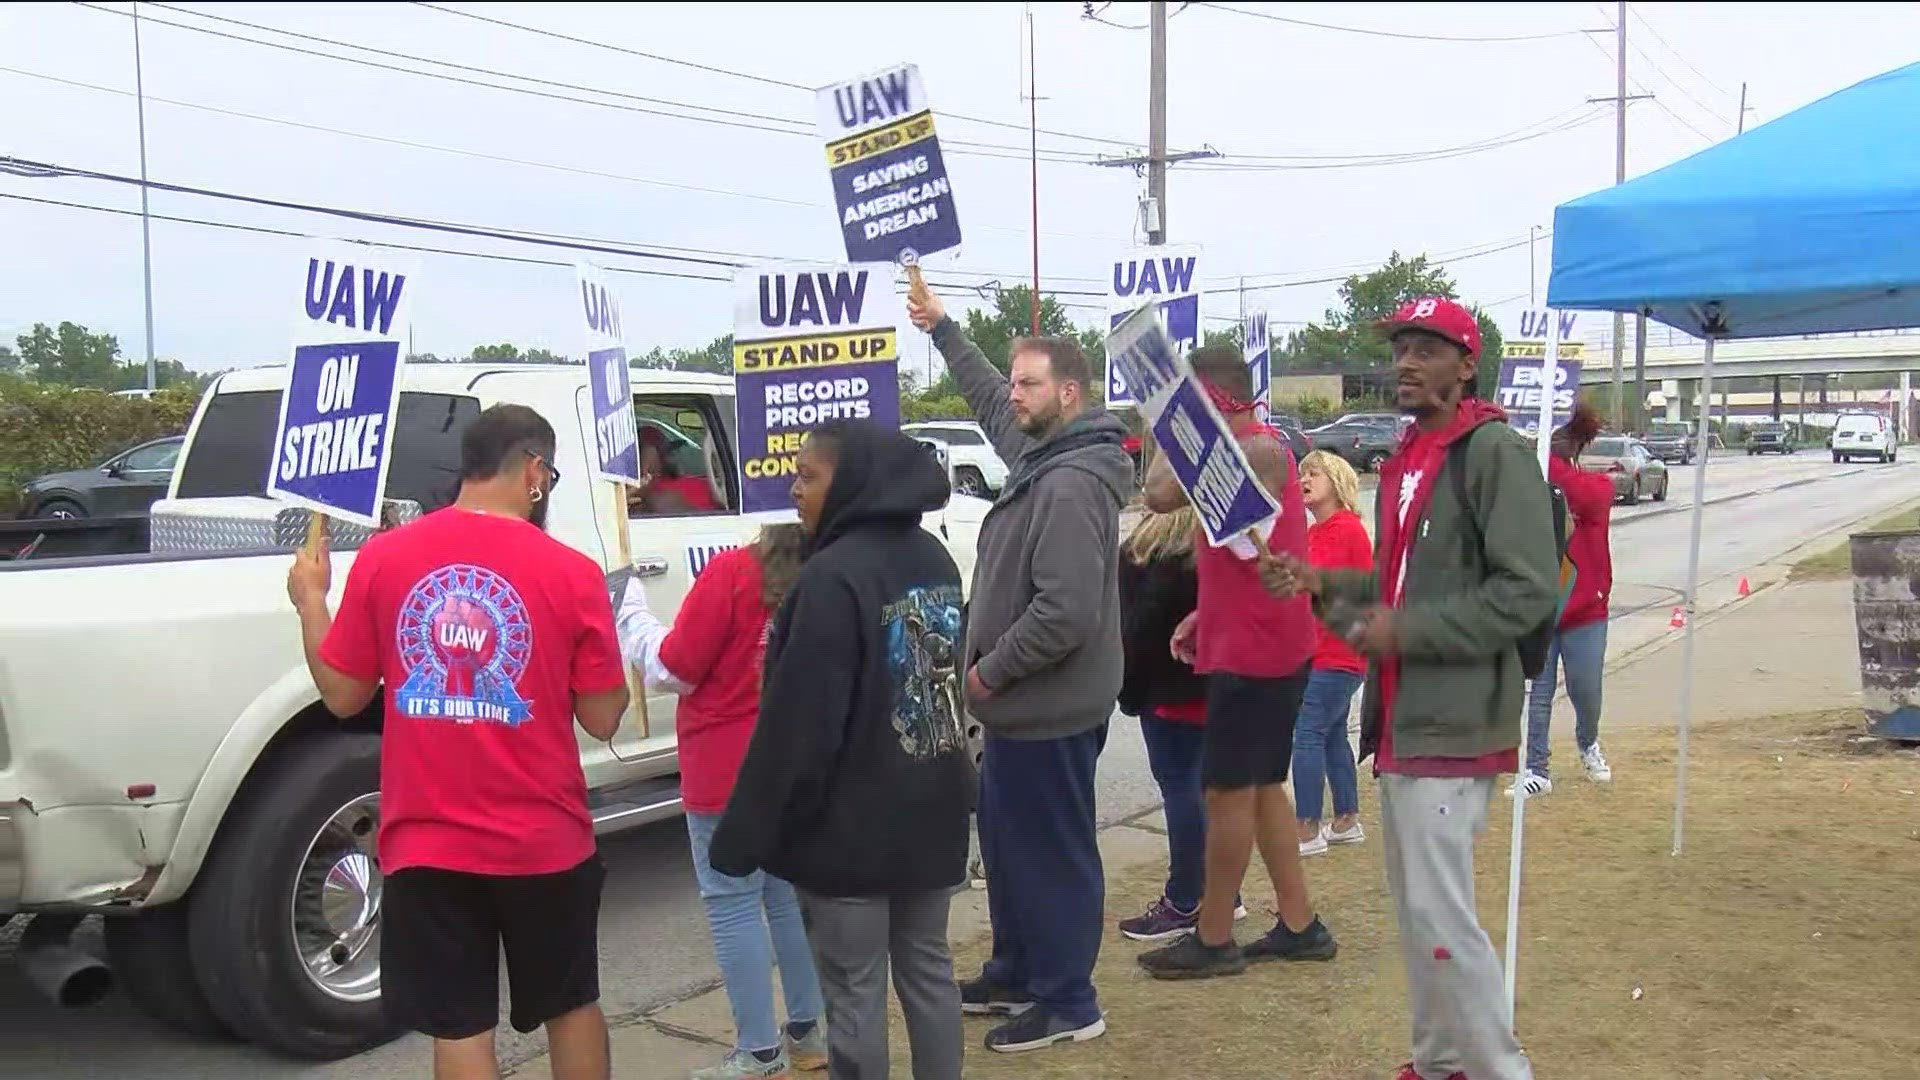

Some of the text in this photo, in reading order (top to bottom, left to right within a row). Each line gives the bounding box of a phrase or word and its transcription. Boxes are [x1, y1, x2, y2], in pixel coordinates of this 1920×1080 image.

[834, 68, 909, 128] UAW
[833, 119, 930, 164] STAND UP
[852, 155, 929, 193] SAVING
[843, 177, 949, 225] AMERICAN
[864, 204, 938, 240] DREAM
[305, 257, 406, 335] UAW
[1113, 257, 1196, 297] UAW
[582, 279, 622, 342] UAW
[759, 270, 869, 327] UAW
[744, 337, 887, 369] STAND UP
[316, 354, 359, 414] ON
[765, 377, 869, 405] RECORD
[1500, 387, 1575, 408] TIES
[765, 399, 870, 429] PROFITS
[281, 412, 384, 482] STRIKE
[745, 455, 799, 478] CON
[440, 622, 488, 653] UAW
[408, 697, 511, 724] IT'S OUR TIME
